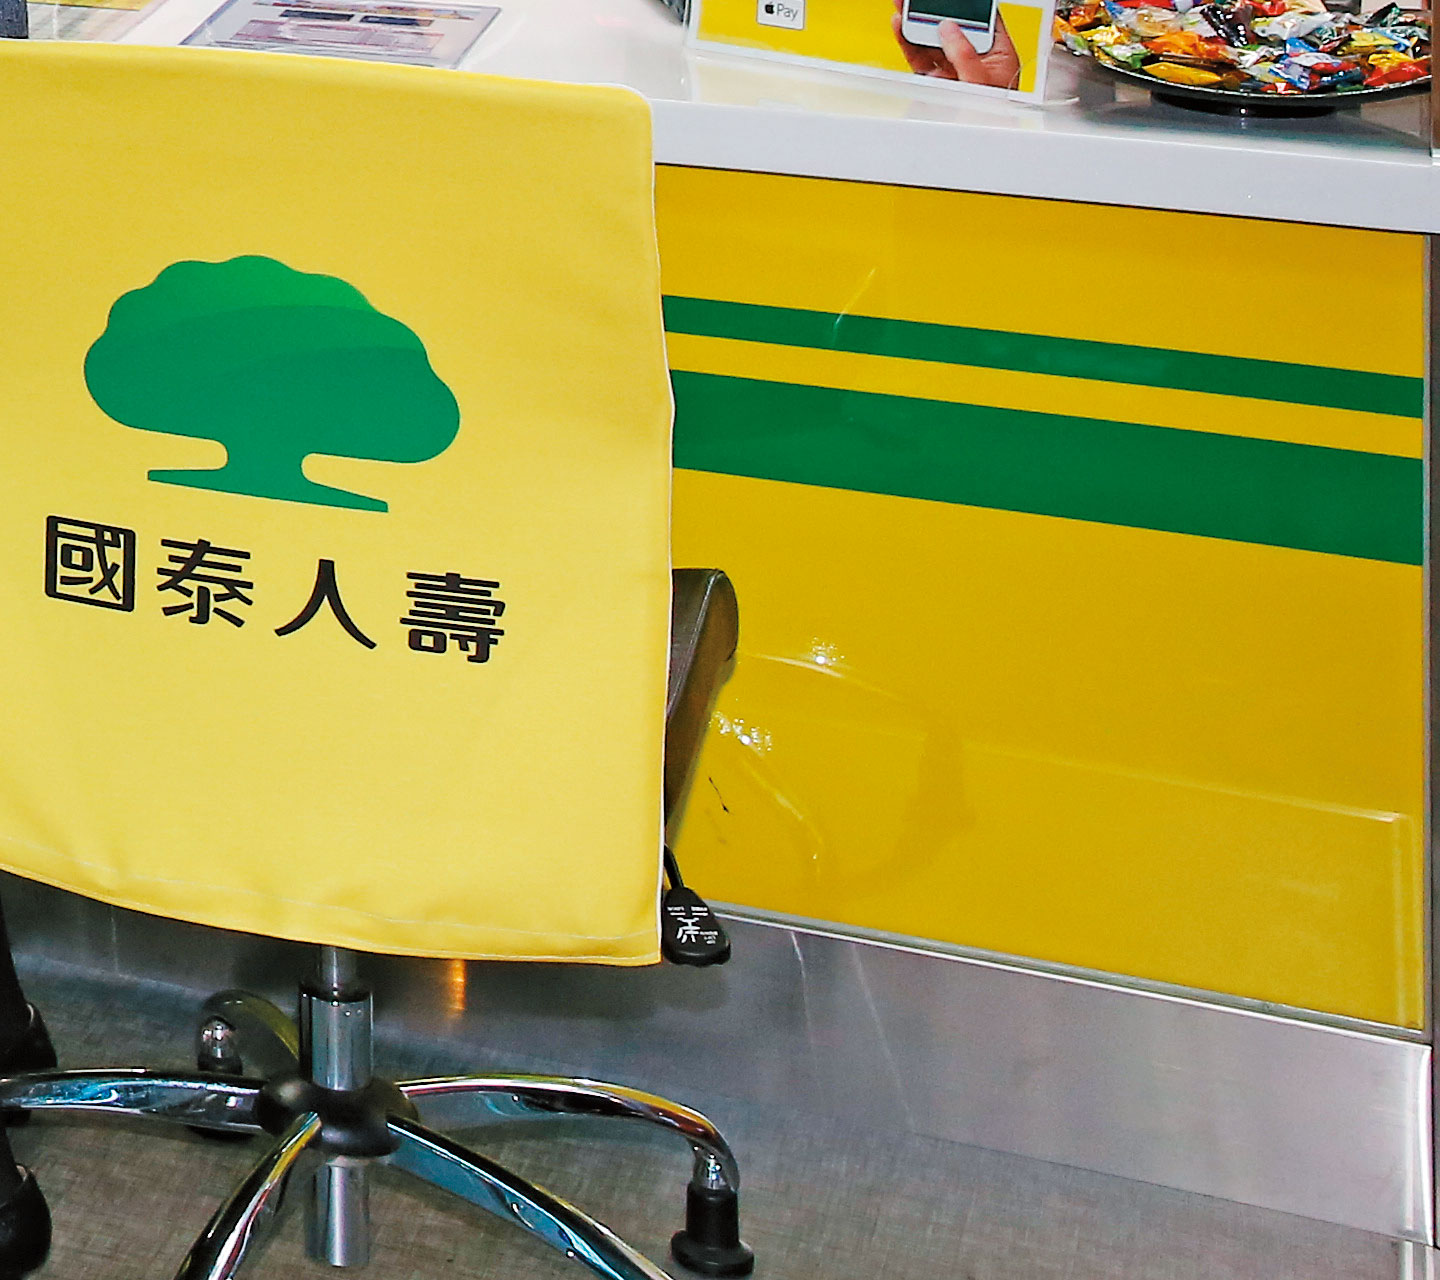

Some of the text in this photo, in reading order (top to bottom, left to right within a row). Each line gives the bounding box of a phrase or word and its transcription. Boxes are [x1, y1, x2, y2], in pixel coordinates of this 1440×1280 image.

[776, 2, 799, 22] Pay
[44, 514, 506, 664] 國泰人壽
